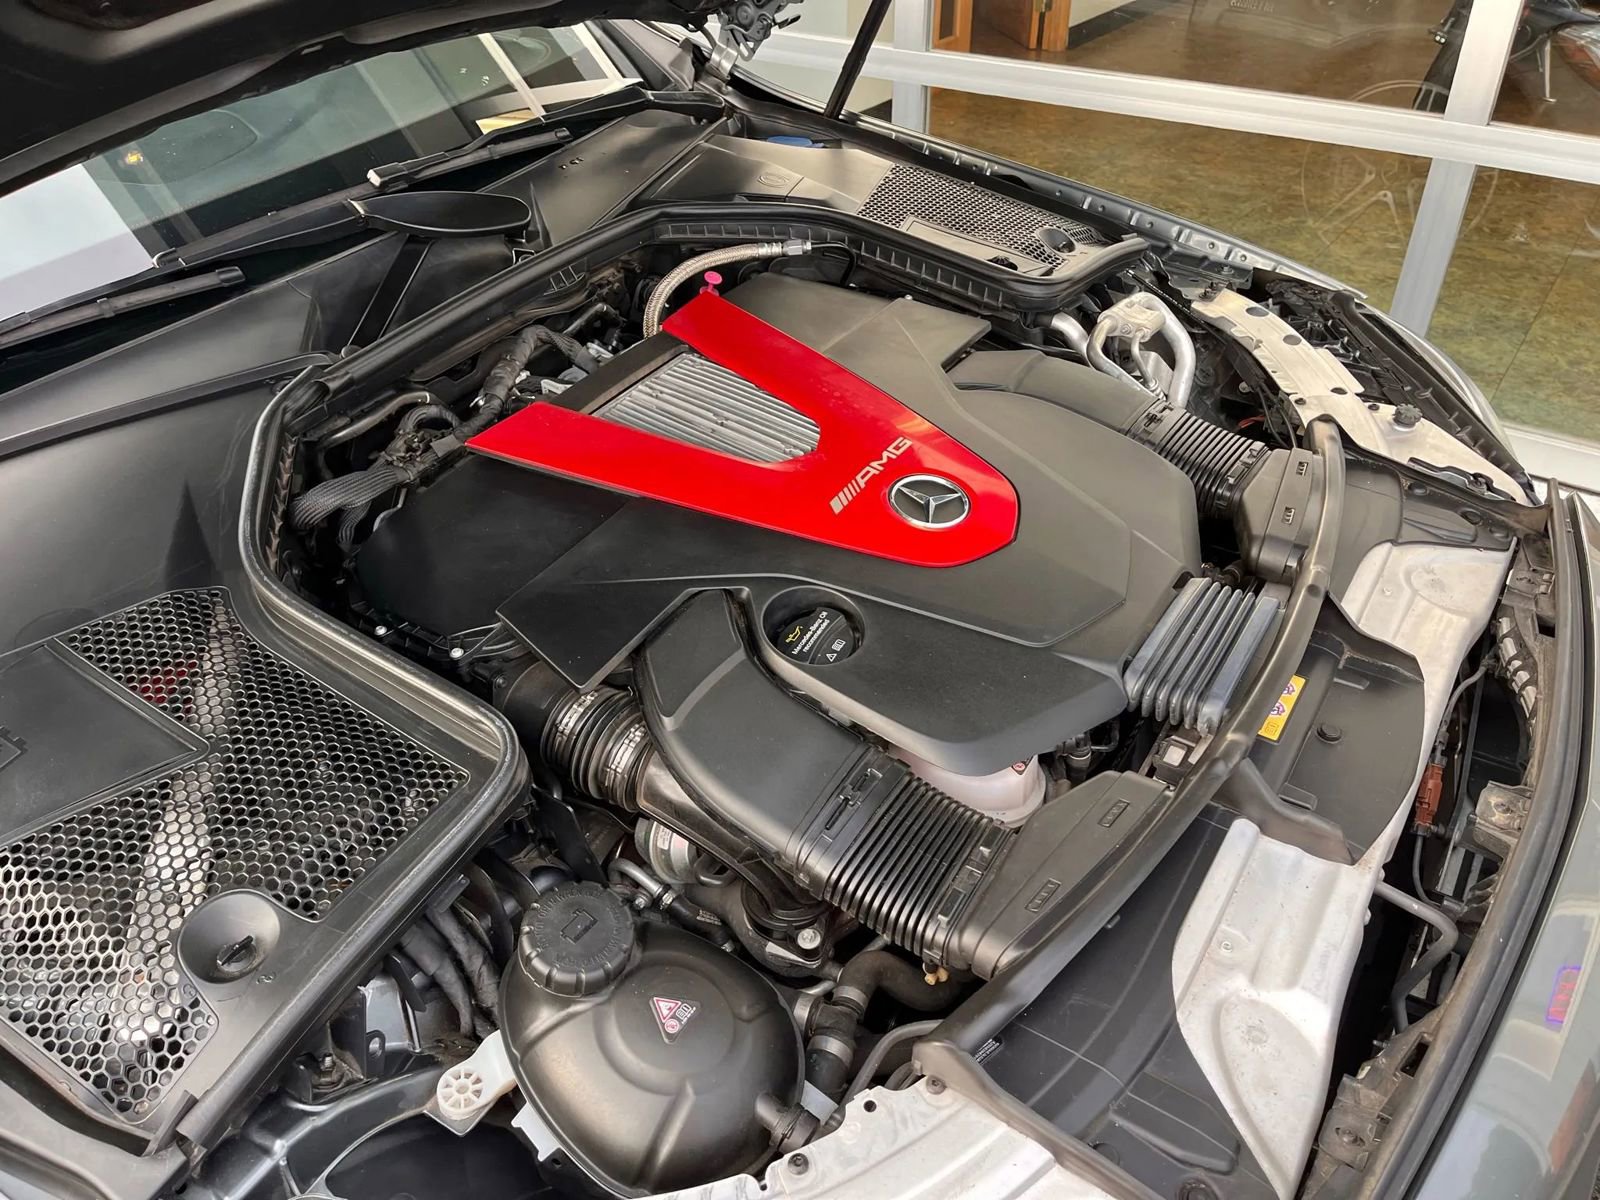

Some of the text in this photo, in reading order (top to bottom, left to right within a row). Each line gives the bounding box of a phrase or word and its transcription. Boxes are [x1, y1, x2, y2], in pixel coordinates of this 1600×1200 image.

[855, 436, 913, 489] AMG
[791, 618, 823, 655] Mercedes-Benz
[802, 619, 830, 653] recommended
